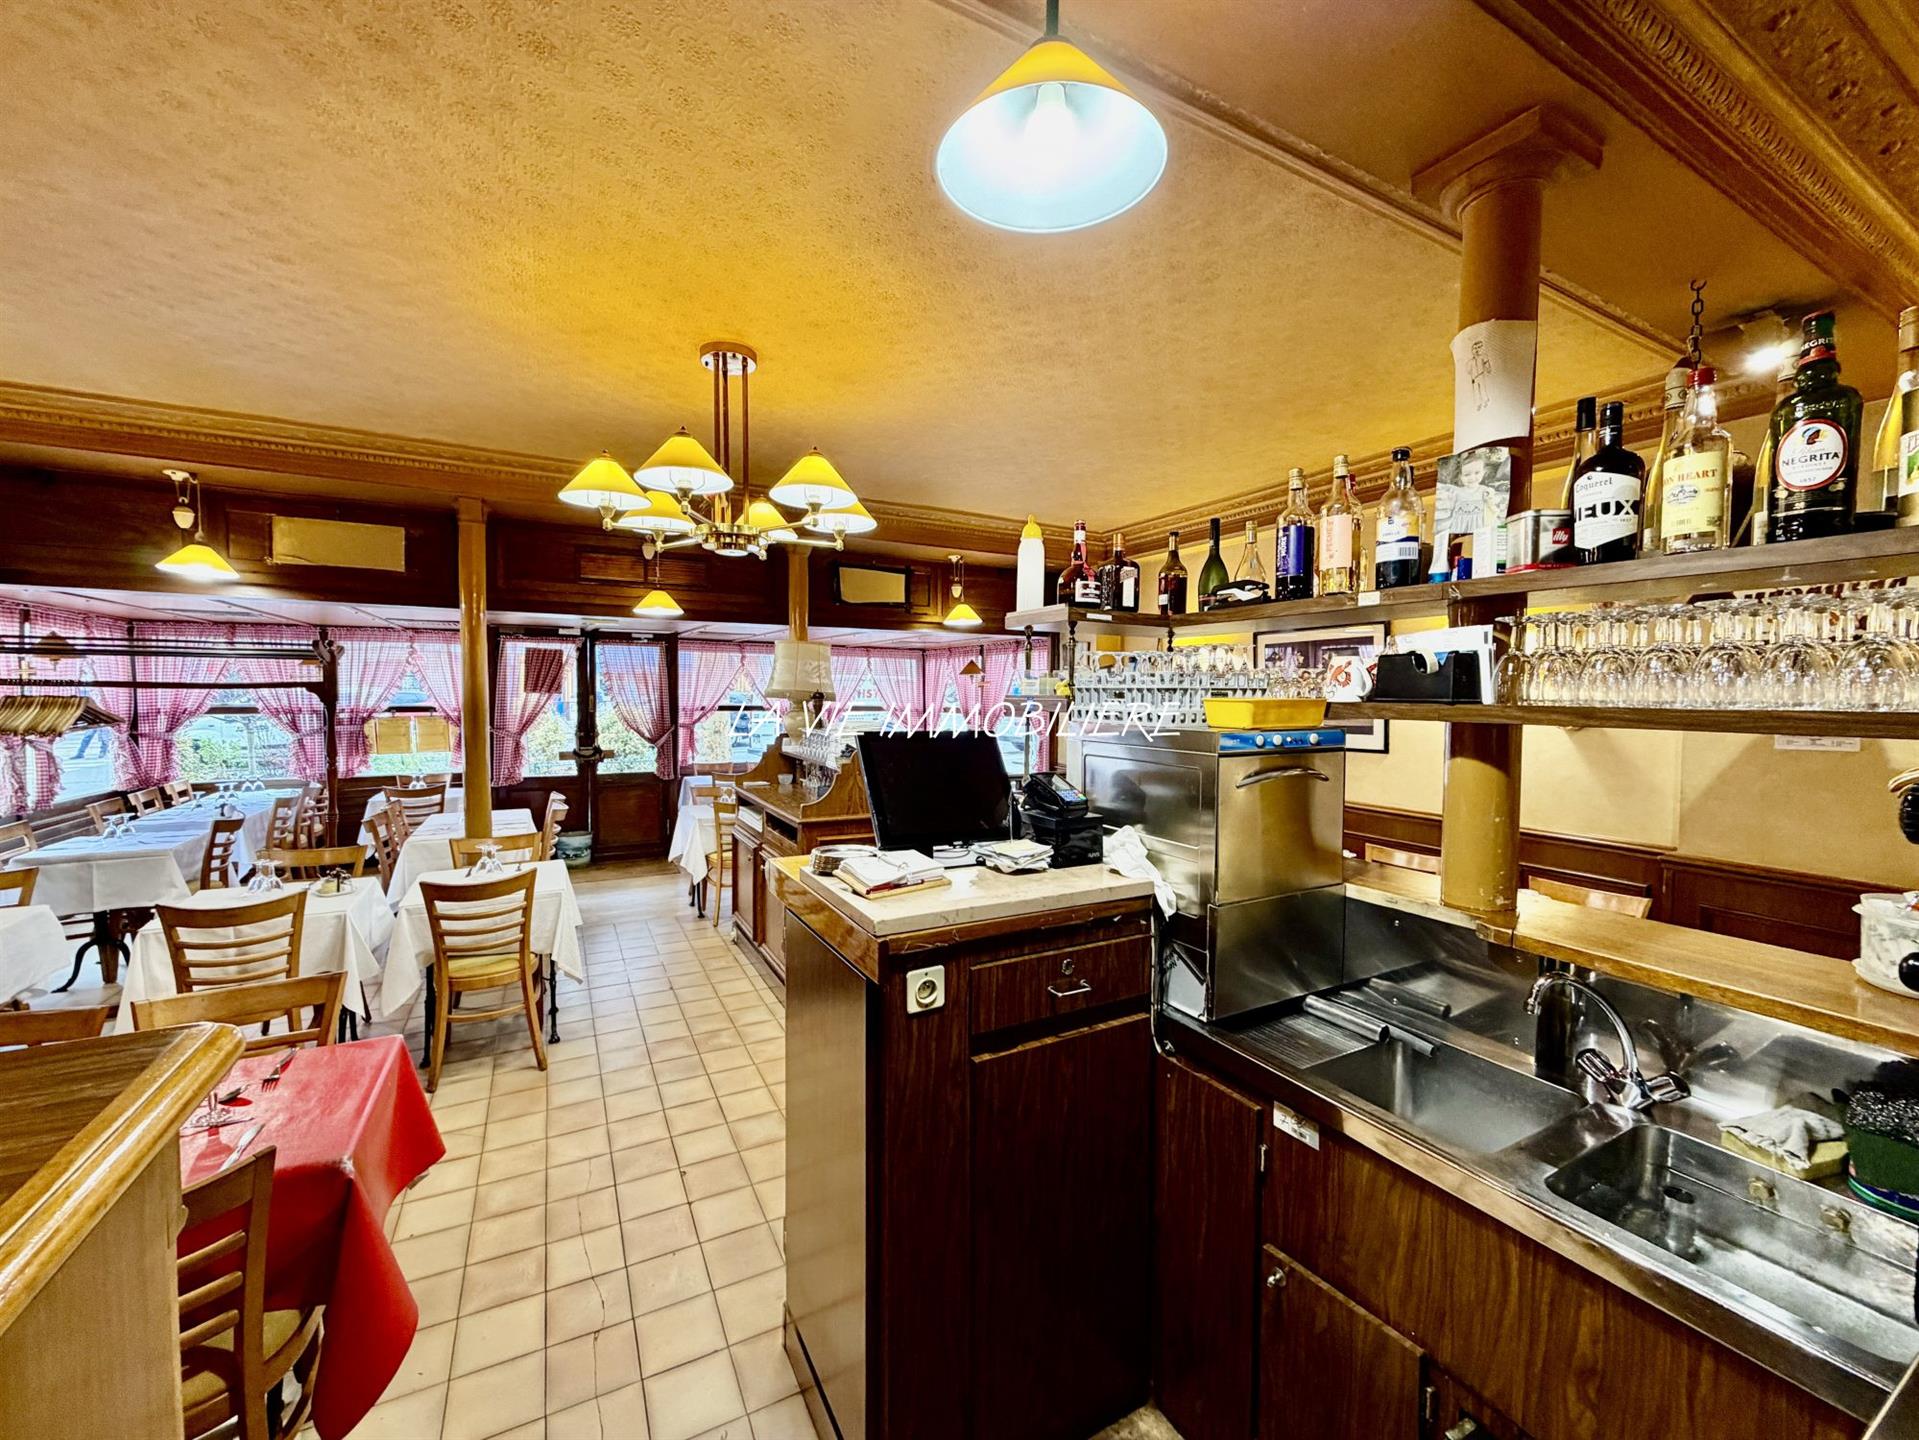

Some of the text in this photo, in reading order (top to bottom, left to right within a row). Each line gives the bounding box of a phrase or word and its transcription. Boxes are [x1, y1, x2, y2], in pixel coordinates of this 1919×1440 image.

[1782, 452, 1840, 466] NEGRITA
[1678, 468, 1718, 482] HEART
[1552, 530, 1569, 542] illy
